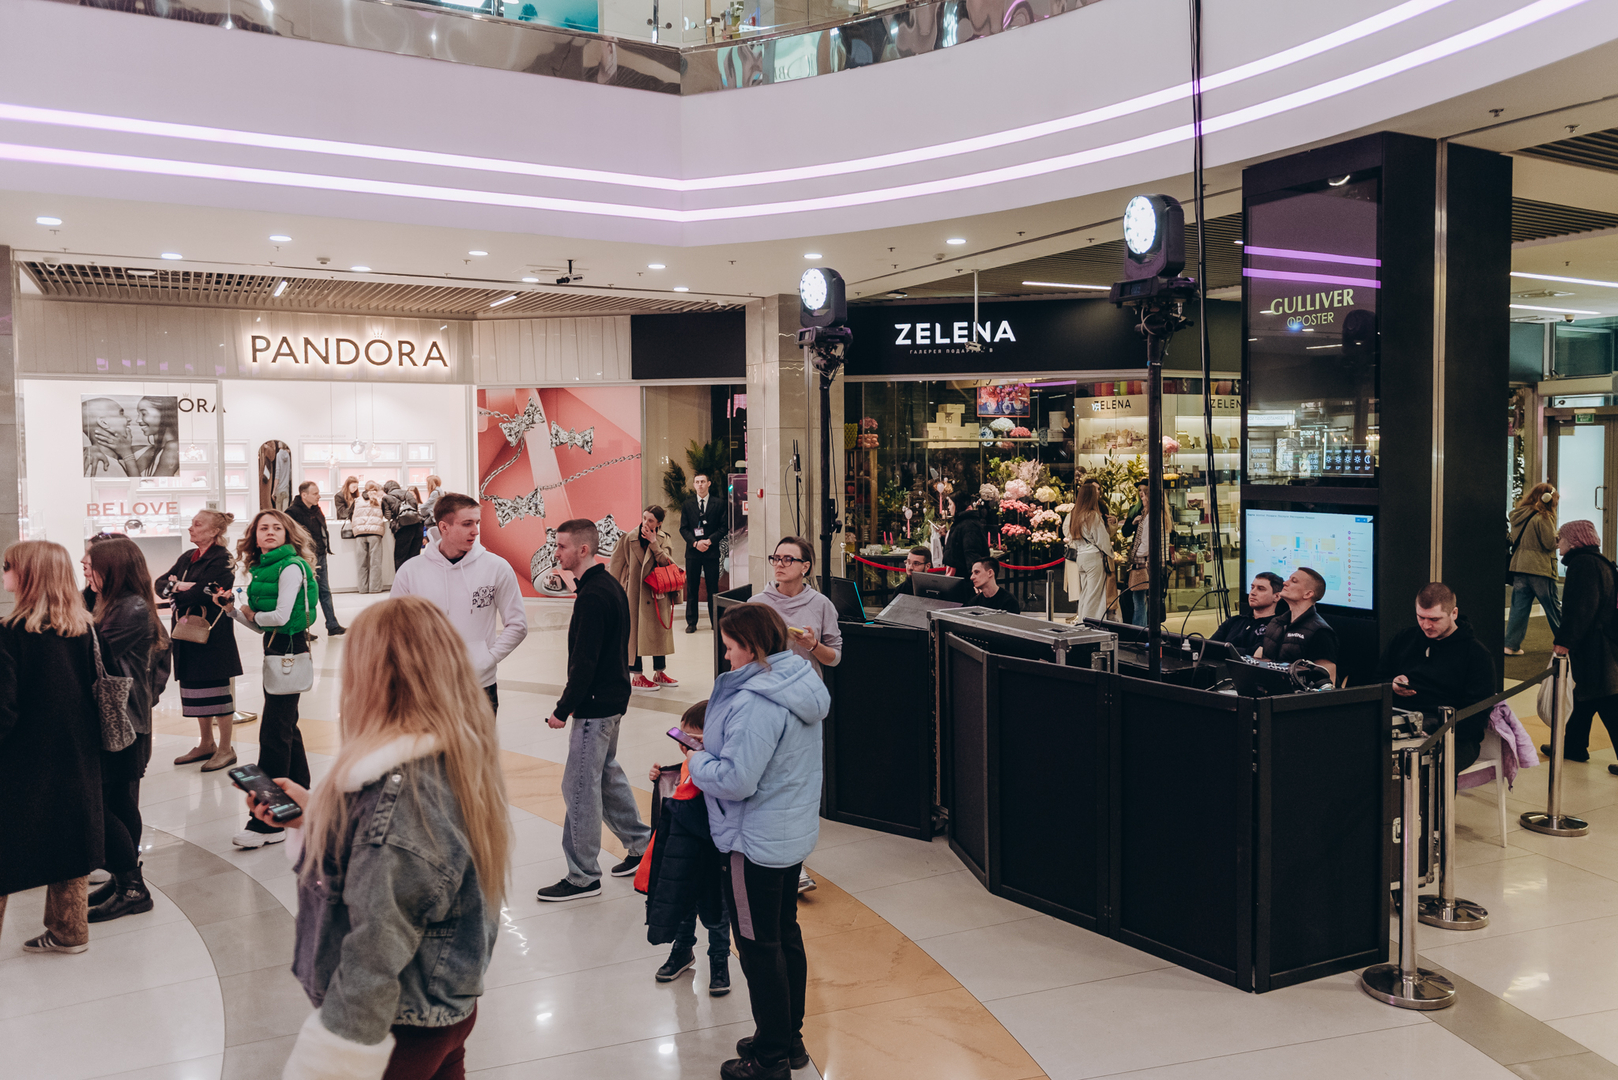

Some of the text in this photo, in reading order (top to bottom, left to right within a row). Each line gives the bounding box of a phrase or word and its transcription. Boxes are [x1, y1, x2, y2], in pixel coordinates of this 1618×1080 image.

[1270, 288, 1354, 315] GULLIVER
[894, 320, 1017, 345] ZELENA
[250, 335, 449, 367] PANDORA
